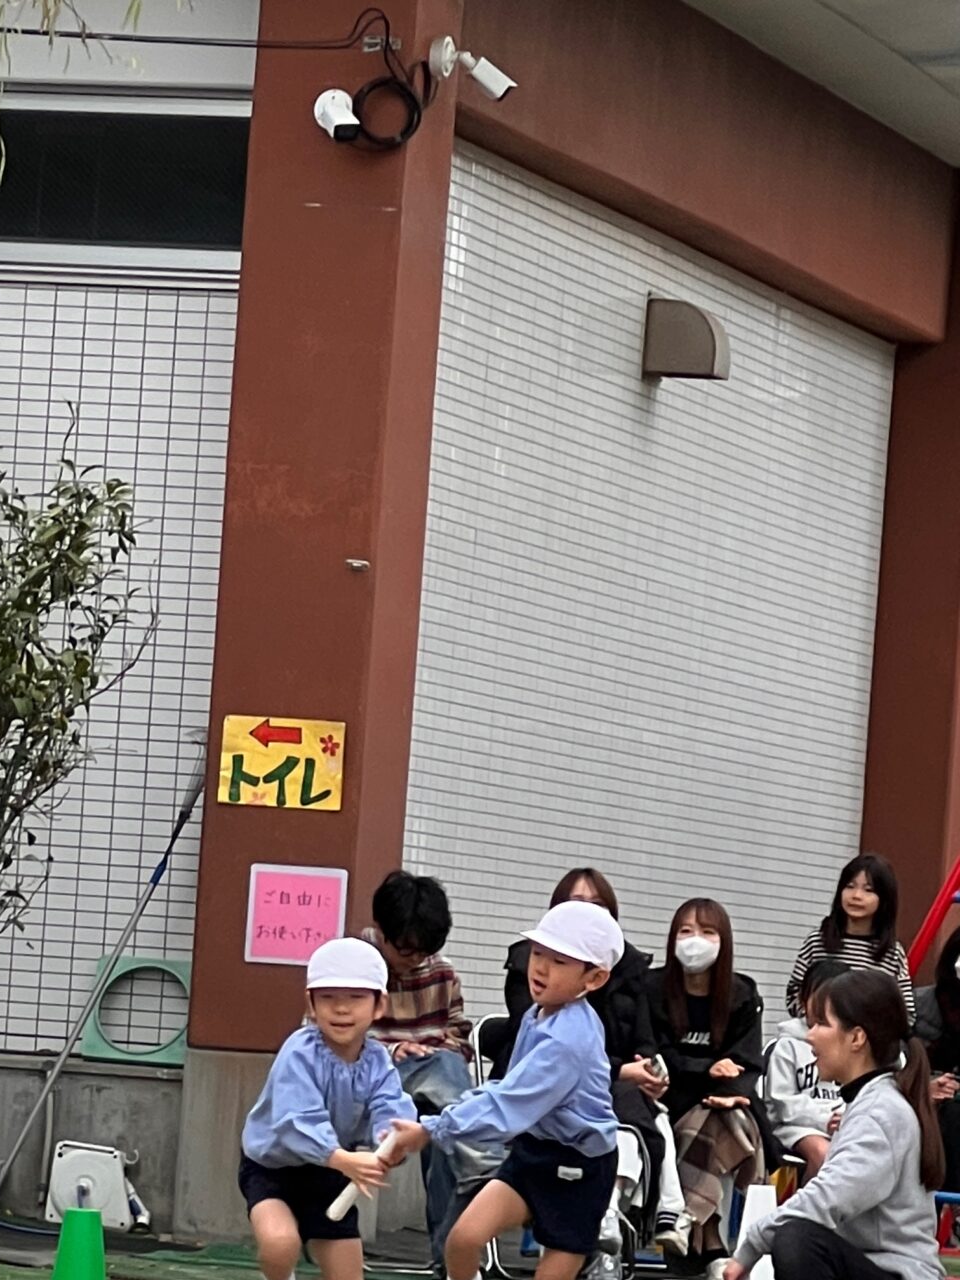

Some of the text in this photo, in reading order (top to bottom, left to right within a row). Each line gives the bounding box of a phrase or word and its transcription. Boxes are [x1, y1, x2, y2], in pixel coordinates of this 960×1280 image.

[229, 754, 332, 807] トイレ
[263, 889, 332, 908] ご自由に
